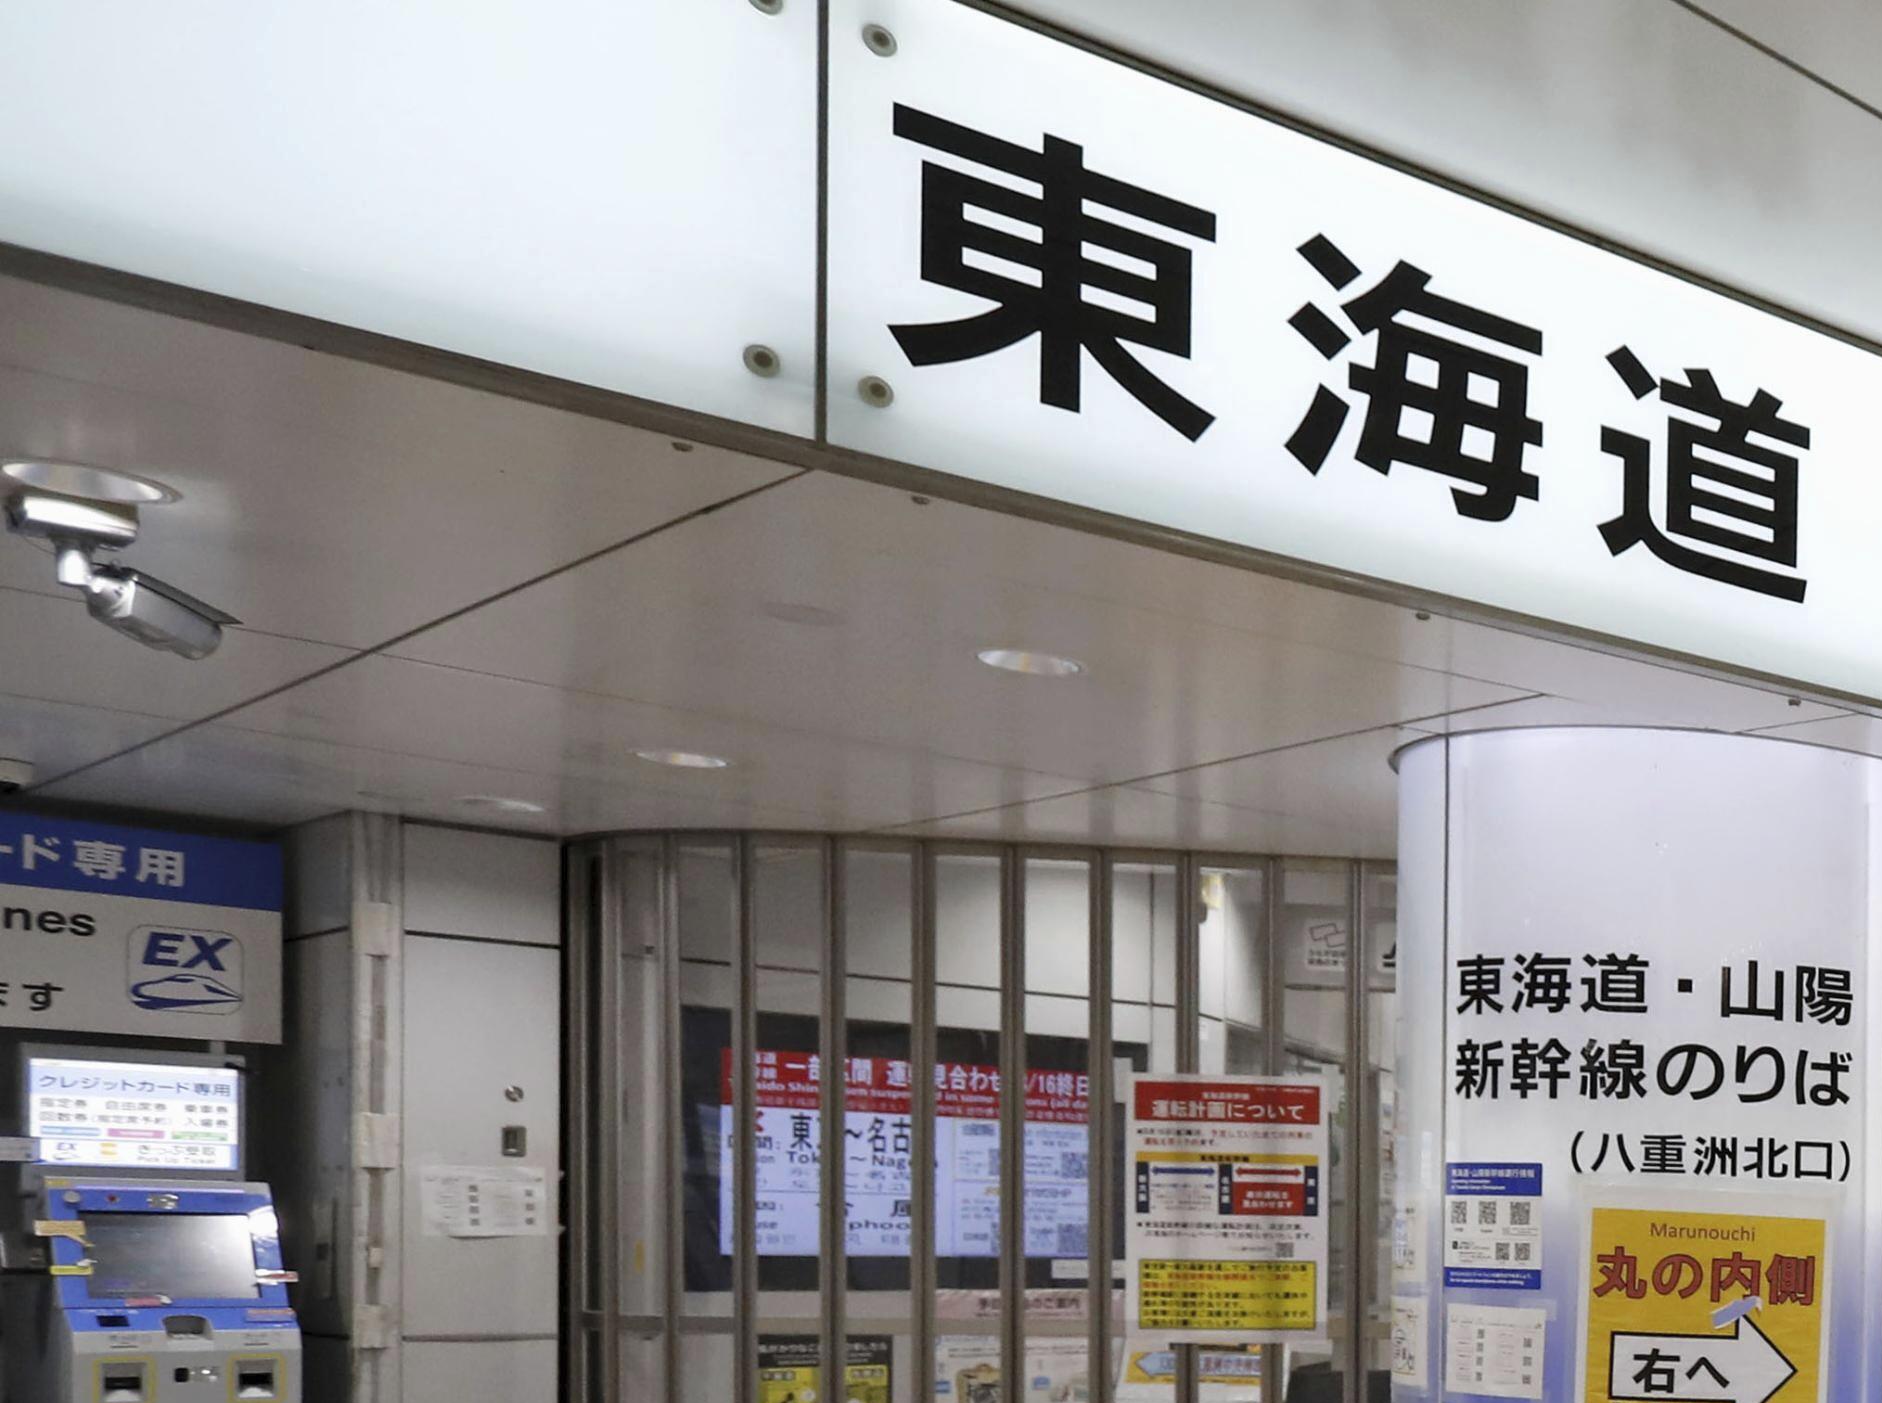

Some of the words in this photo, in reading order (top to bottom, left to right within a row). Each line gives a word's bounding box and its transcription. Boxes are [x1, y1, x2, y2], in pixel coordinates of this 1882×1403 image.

[142, 931, 233, 972] EX
[1456, 952, 1853, 1026] 東海道・山陽
[39, 1075, 231, 1096] クレジットカード専用
[1454, 1037, 1852, 1107] 新幹線のりば
[1570, 1130, 1852, 1182] (八重洲北口)
[1649, 1222, 1756, 1243] Marunouchi
[1594, 1245, 1815, 1306] 丸の内側
[1632, 1347, 1732, 1394] 右へ
